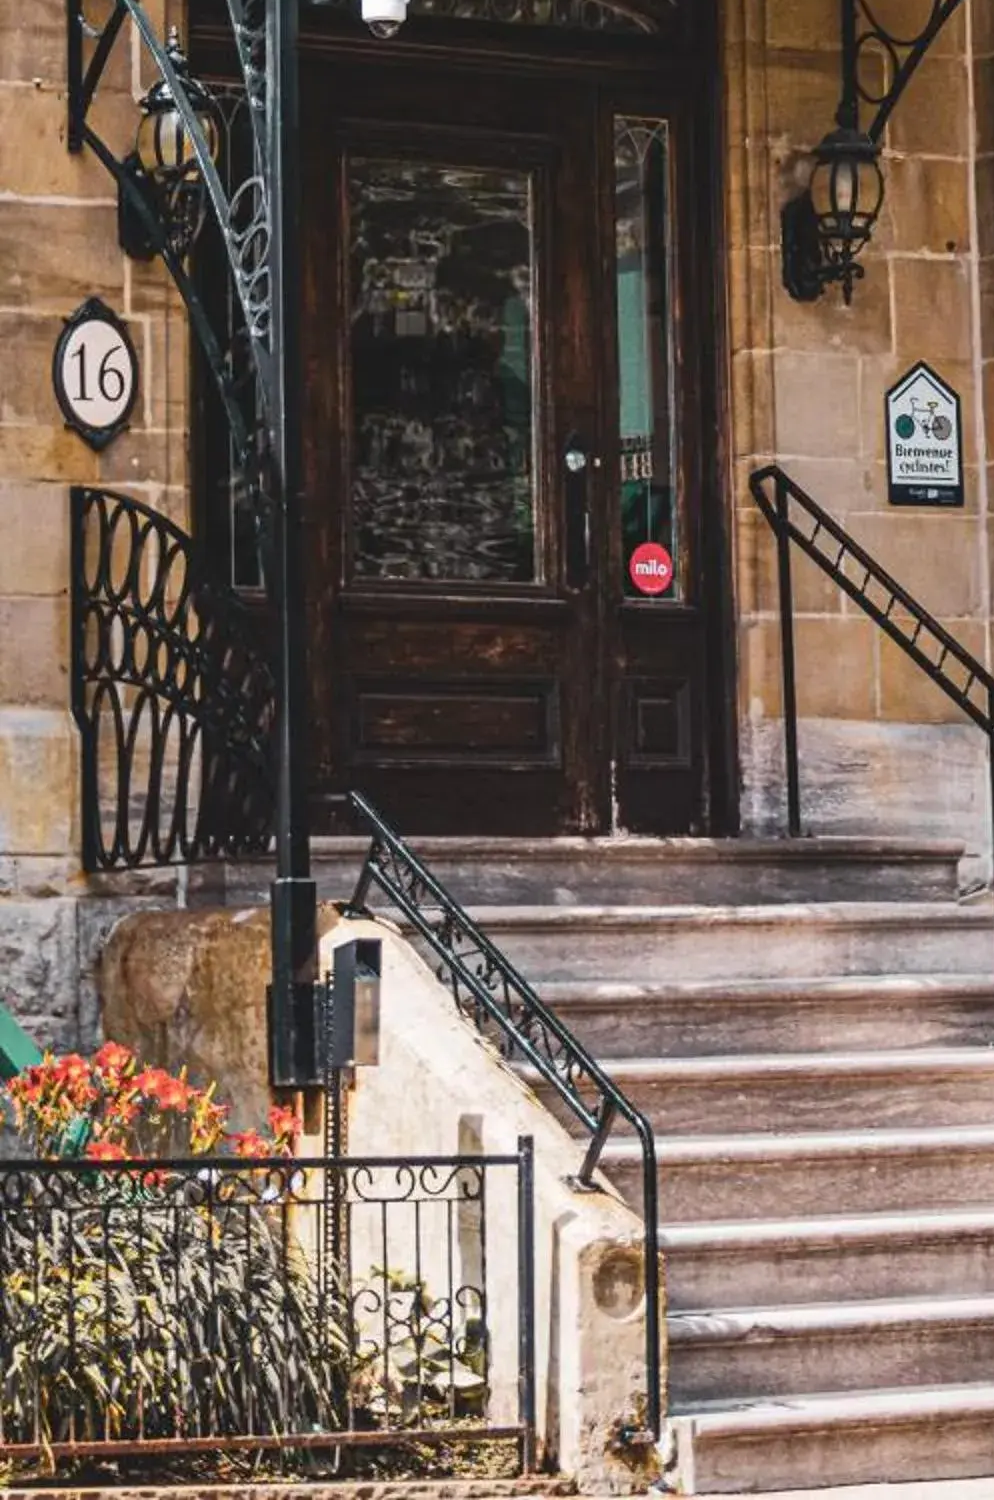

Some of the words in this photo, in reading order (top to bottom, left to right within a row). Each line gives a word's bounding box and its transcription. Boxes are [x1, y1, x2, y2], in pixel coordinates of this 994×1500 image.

[71, 342, 125, 402] 16
[895, 443, 953, 458] Bienvenue
[635, 559, 668, 576] milo
